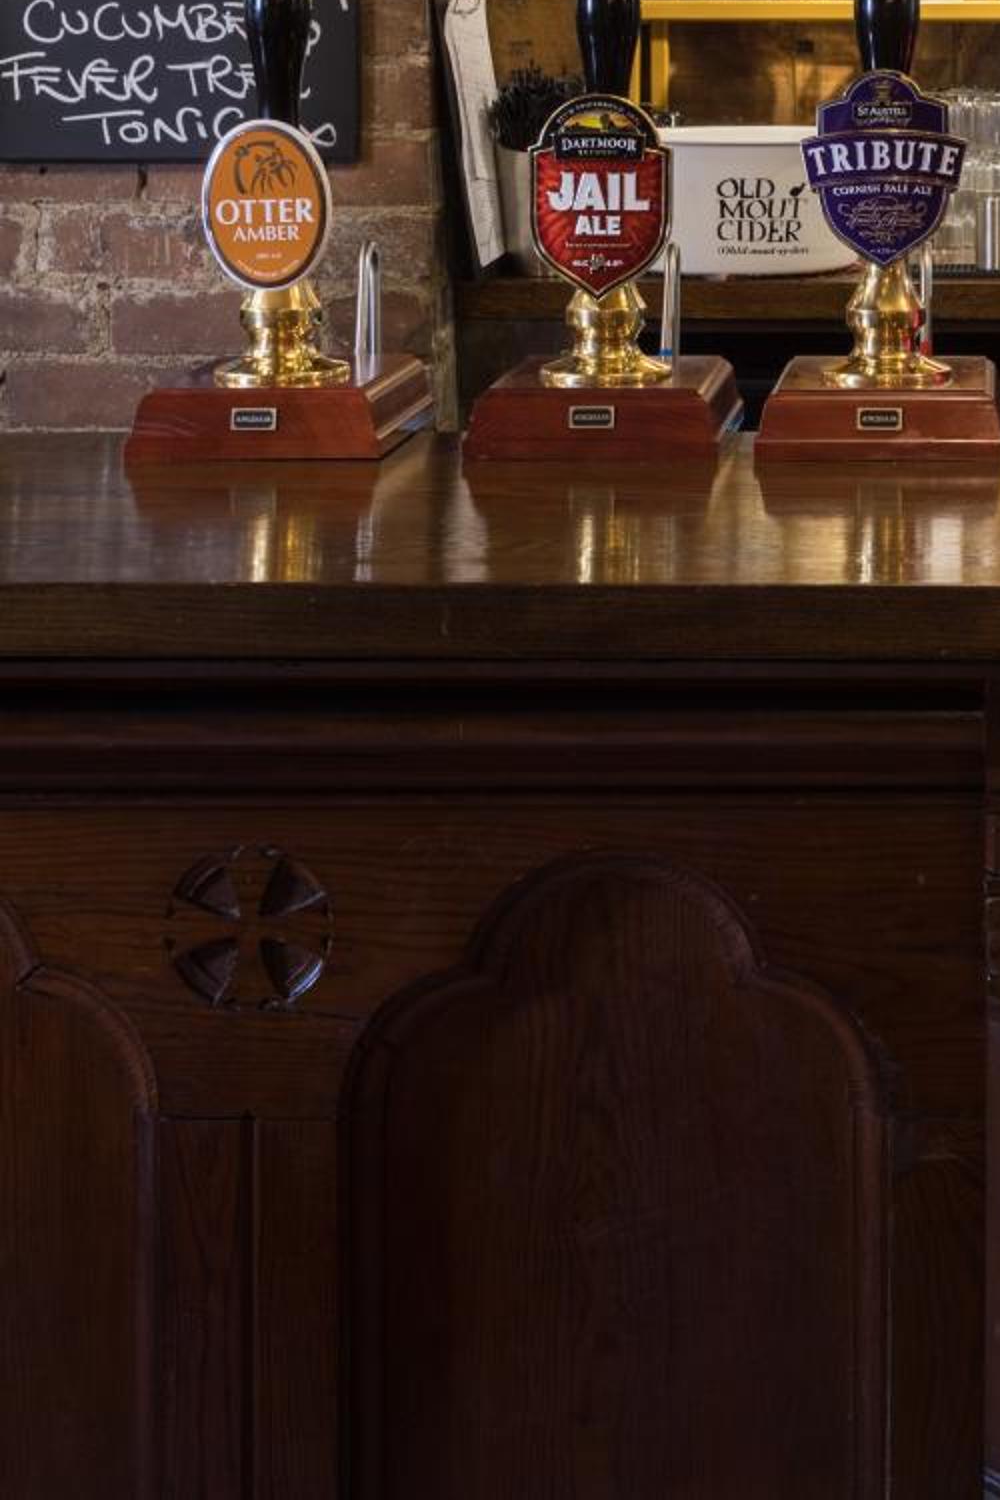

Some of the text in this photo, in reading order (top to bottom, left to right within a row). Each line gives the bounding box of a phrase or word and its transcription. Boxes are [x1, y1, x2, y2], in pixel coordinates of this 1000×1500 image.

[0, 52, 158, 102] FEVER
[561, 137, 637, 152] DARTMOOR
[806, 139, 960, 177] TRIBUTE
[546, 171, 650, 211] JAIL
[716, 178, 775, 199] OLD
[882, 183, 909, 196] PALE
[912, 185, 933, 197] ALE
[215, 198, 314, 225] OTTER
[719, 199, 800, 219] MOUT
[232, 225, 301, 242] AMBER
[575, 214, 621, 236] ALE
[717, 220, 802, 243] CIDER
